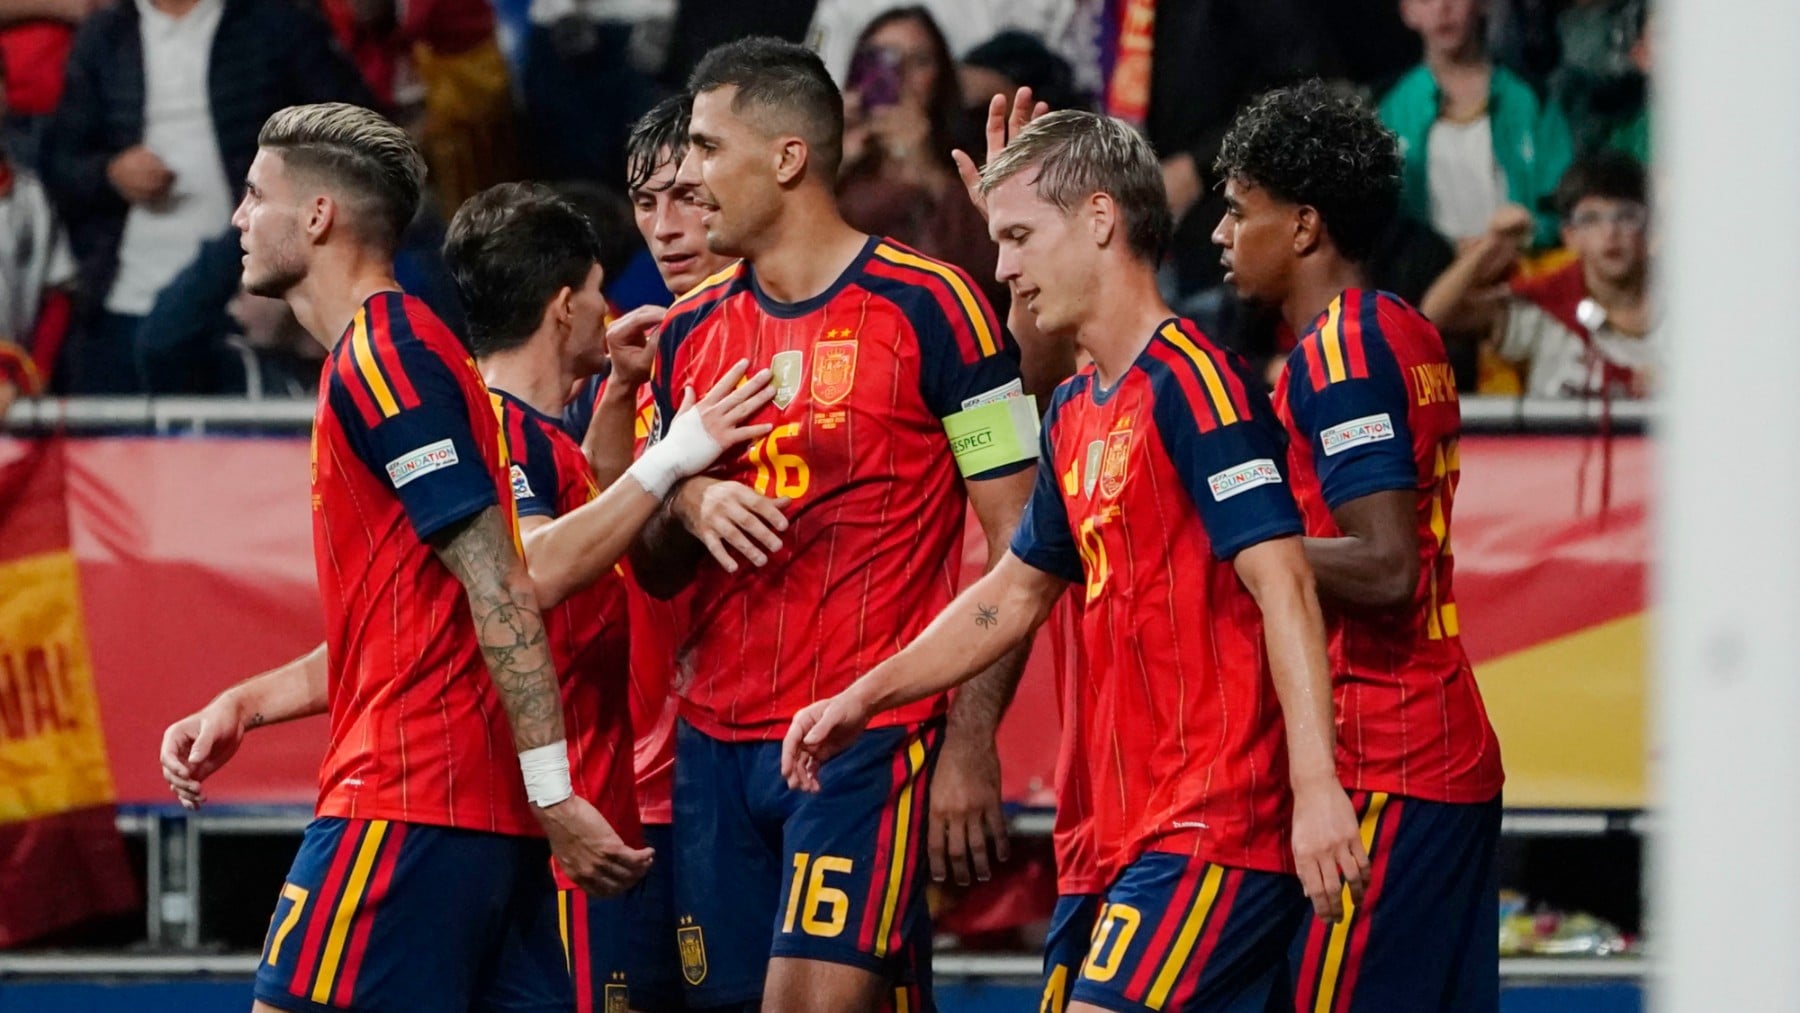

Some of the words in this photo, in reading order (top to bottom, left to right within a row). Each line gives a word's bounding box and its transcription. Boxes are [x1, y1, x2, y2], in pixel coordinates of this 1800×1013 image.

[749, 422, 810, 499] 16
[951, 431, 992, 454] ESPECT
[782, 852, 853, 938] 16
